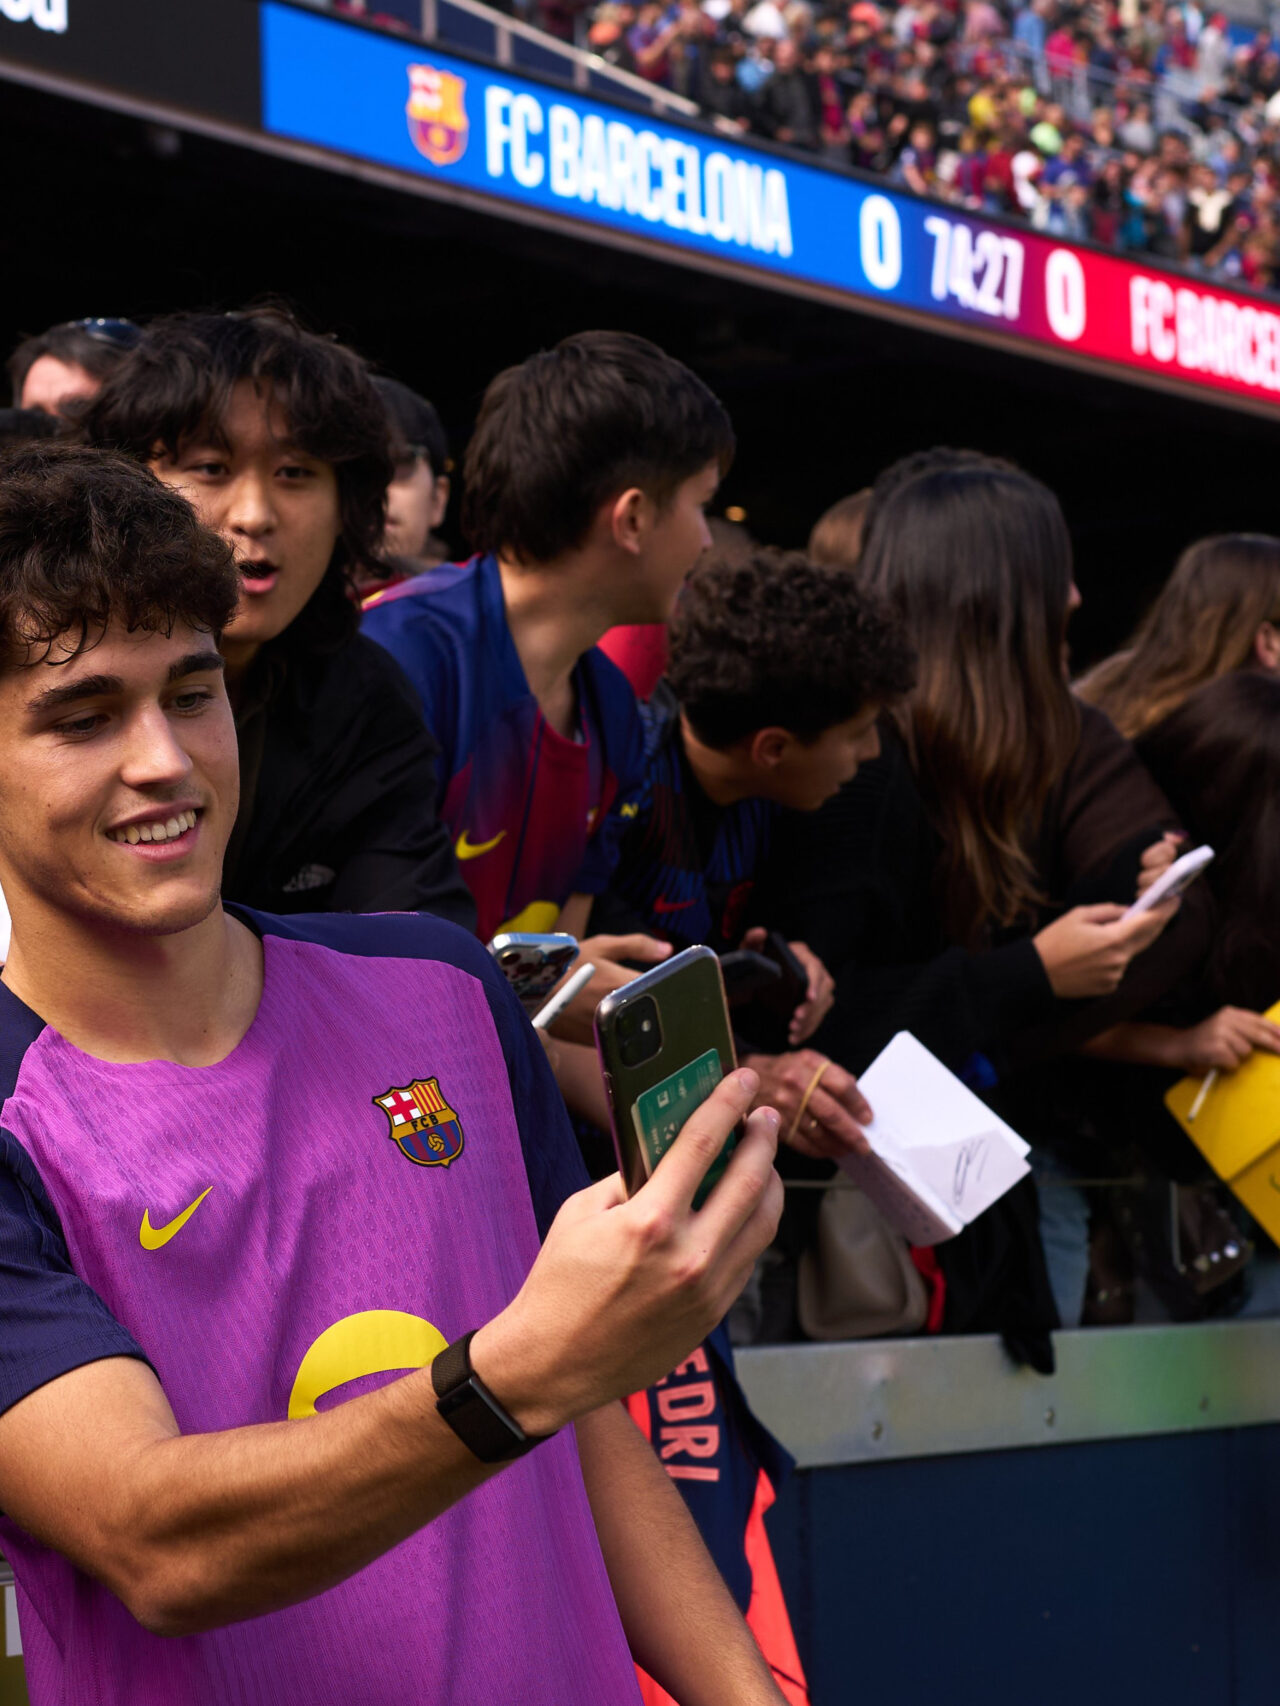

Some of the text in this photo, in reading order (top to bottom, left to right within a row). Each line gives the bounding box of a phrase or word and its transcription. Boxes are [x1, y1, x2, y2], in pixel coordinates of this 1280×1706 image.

[485, 84, 545, 188] FC
[548, 103, 793, 259] BARCELONA
[859, 193, 903, 291] 0
[1045, 247, 1088, 342] 0
[1130, 274, 1176, 363] FC
[410, 1114, 440, 1132] FCB
